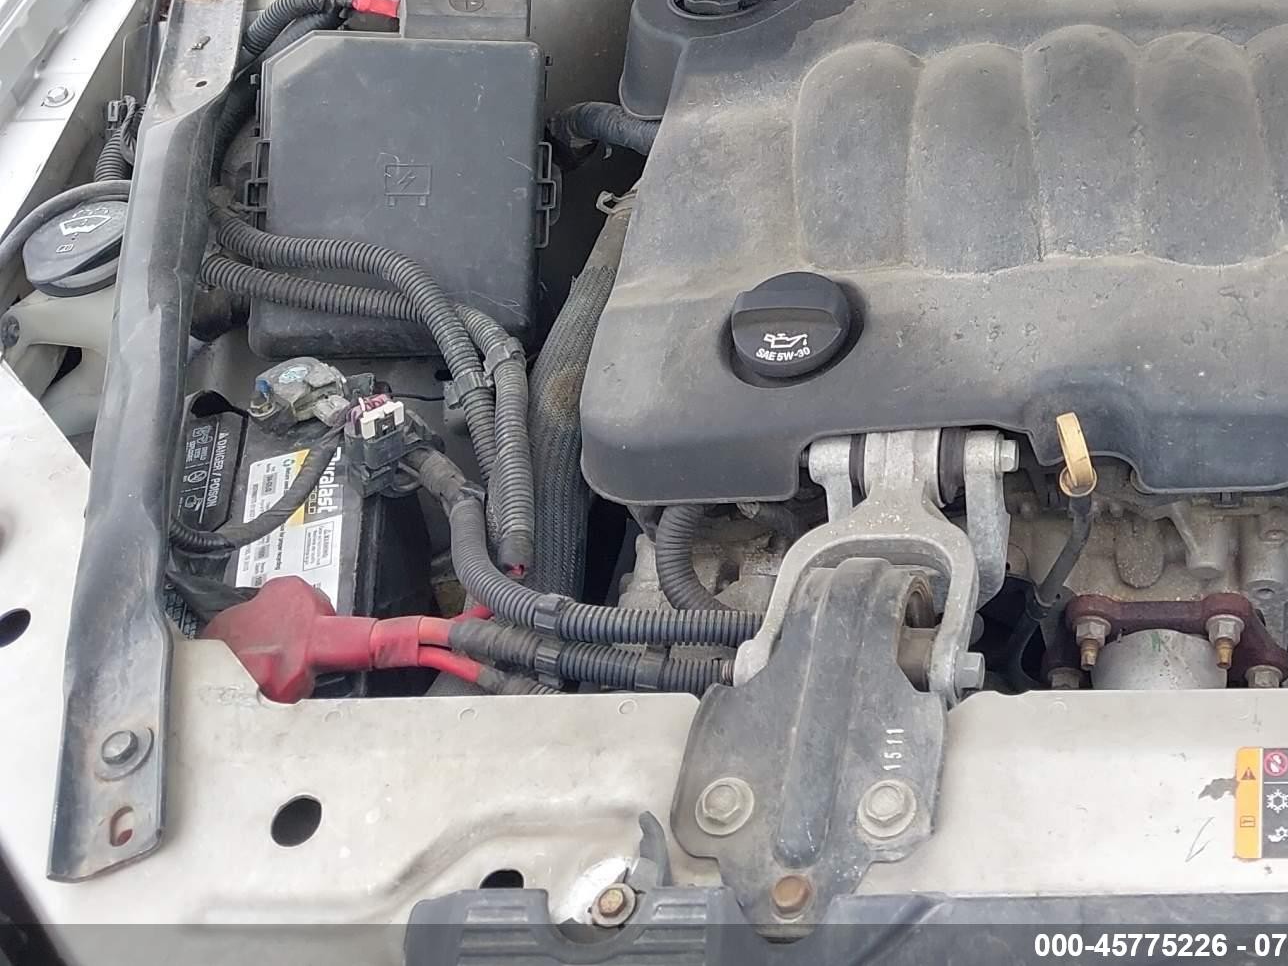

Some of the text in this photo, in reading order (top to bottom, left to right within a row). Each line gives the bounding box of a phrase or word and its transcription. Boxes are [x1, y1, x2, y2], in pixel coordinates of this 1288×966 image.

[755, 346, 811, 361] SAE 5W-30
[213, 440, 227, 470] DANGER
[206, 478, 221, 507] POISON
